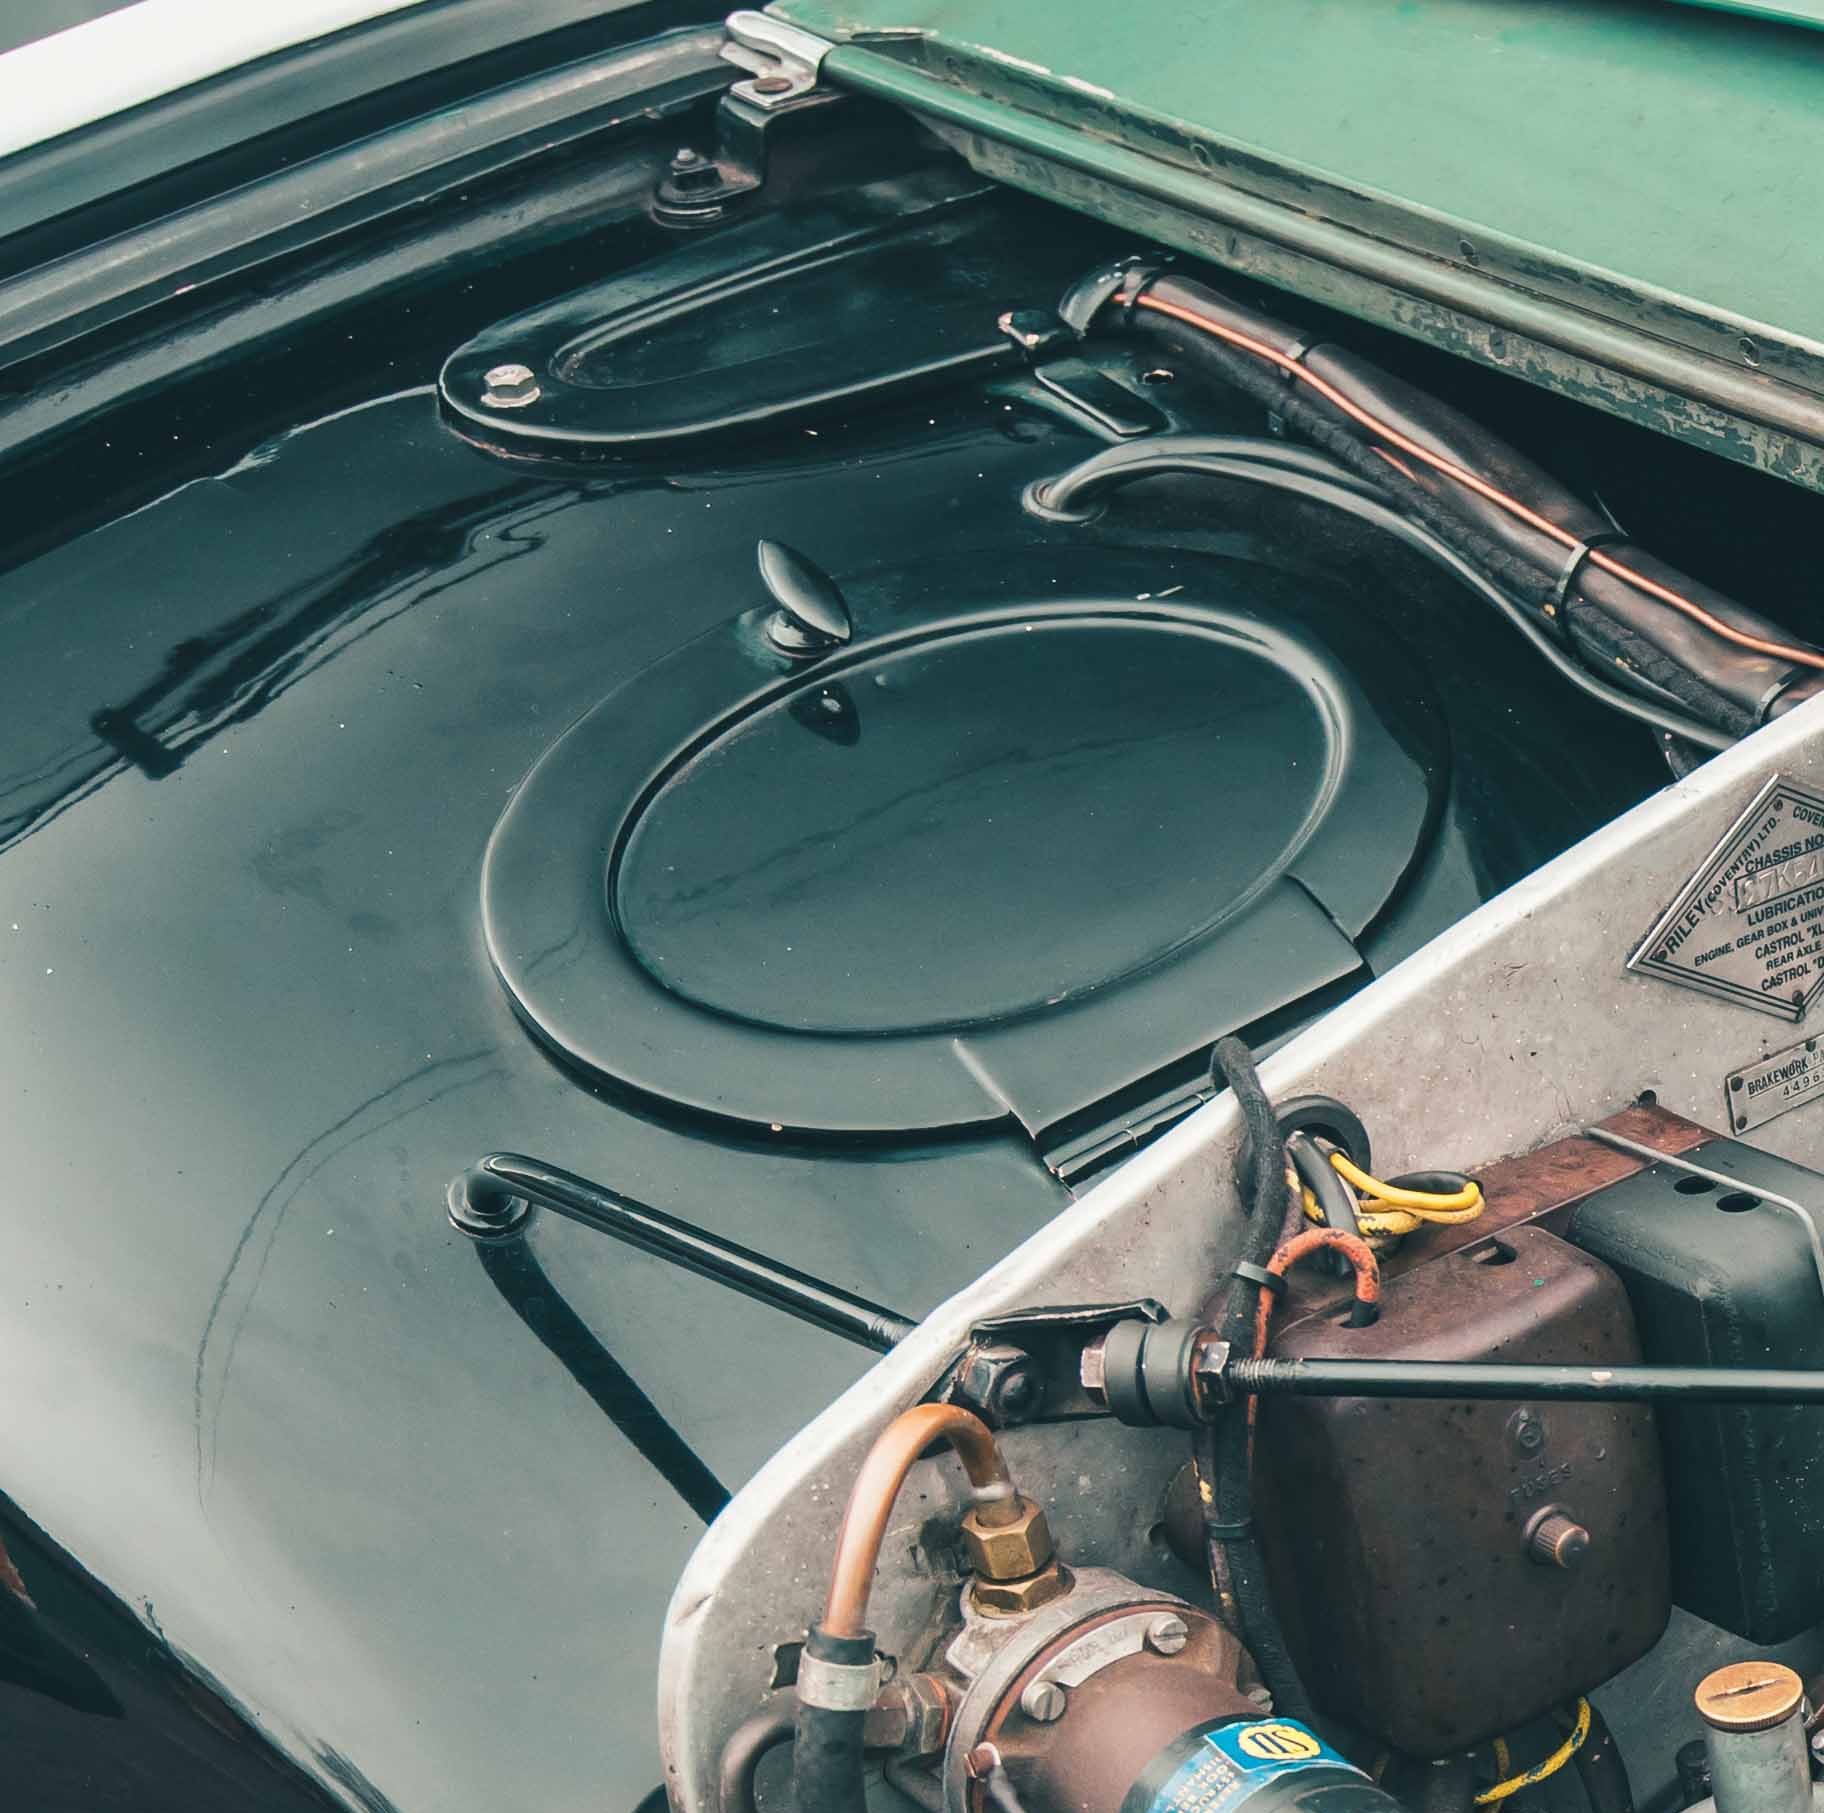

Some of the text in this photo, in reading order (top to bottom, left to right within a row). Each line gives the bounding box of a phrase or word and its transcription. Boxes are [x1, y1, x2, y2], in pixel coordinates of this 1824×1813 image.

[1744, 842, 1803, 873] CHASSIS
[1667, 903, 1708, 955] RILEY
[1758, 815, 1781, 844] LTD.
[1736, 929, 1766, 950] GEAR
[1767, 922, 1789, 942] BOX
[1789, 918, 1799, 932] &
[1755, 933, 1805, 960] CASTROL
[1766, 940, 1823, 971] REAR AXLE
[1761, 964, 1811, 992] CASTROL
[1747, 1058, 1809, 1096] BRAKEWORK
